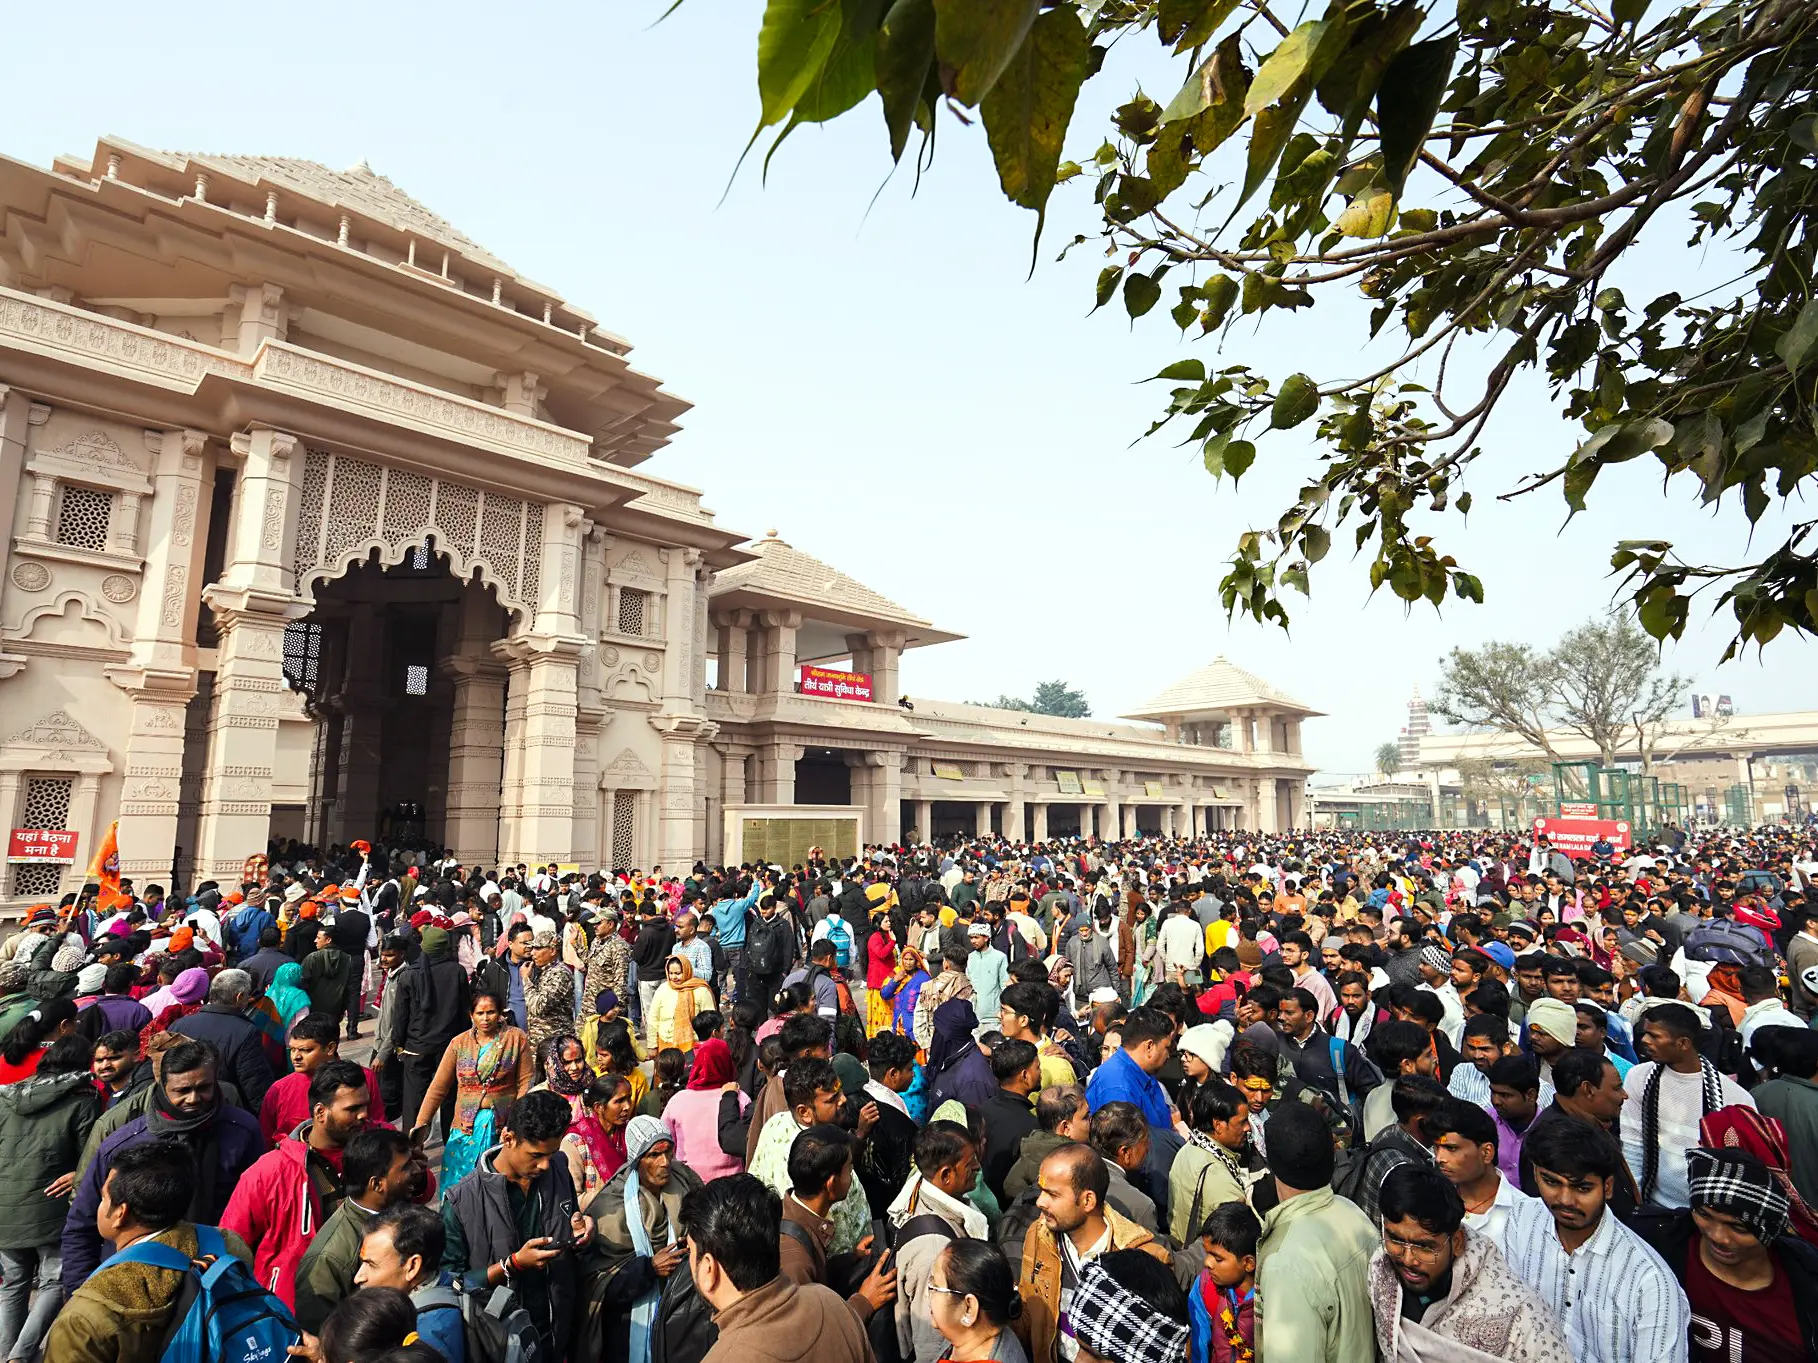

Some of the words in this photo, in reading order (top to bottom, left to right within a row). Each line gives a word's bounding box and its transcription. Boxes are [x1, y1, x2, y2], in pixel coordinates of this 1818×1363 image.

[803, 677, 817, 690] तीर्थ
[818, 681, 833, 692] यात्री
[834, 683, 854, 697] सुविधा
[16, 832, 39, 842] यहां
[41, 831, 72, 843] बैठना
[24, 845, 48, 855] मना
[50, 844, 60, 856] है
